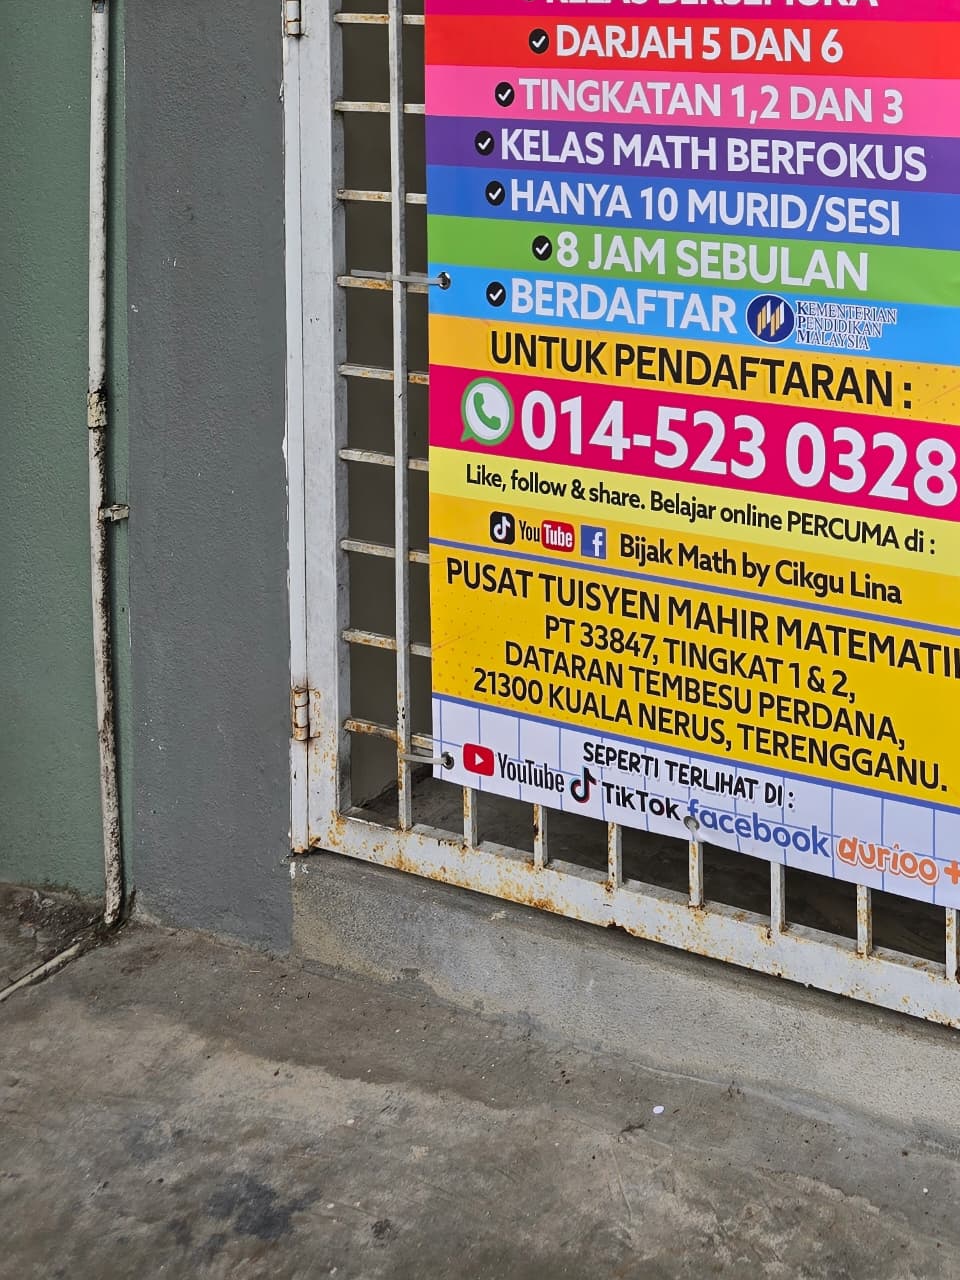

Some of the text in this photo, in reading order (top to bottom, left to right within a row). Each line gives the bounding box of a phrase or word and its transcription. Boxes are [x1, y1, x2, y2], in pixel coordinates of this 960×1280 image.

[556, 25, 811, 61] DARJAH DAN
[519, 78, 872, 123] TINGKATAN 1,2 DAN
[501, 128, 927, 181] KELAS MATH BERFOKUS
[511, 179, 900, 236] HANYA 10 MURID/SESI
[586, 235, 868, 291] JAM SEBULAN
[511, 279, 737, 333] BERDAFTAR
[797, 301, 897, 324] KEMENTERIAN
[797, 316, 882, 336] PENDIDIKAN
[796, 330, 869, 350] MALAYSIA
[491, 332, 893, 407] UNTUK PENDAFTARAN
[520, 389, 957, 507] 014-523 0328
[465, 463, 899, 550] Like, follow share. Belajar online PERCUMA
[620, 535, 902, 605] Bijak Math by Cikgu Lina
[447, 558, 533, 601] PUSAT
[539, 574, 662, 623] TUISYEN
[668, 597, 770, 642] MAHIR
[545, 616, 783, 685] PT 33847, TINGKAT
[505, 641, 905, 750] DATARAN TEMBESU PERDANA,
[474, 668, 948, 791] 21300 KUALA NERUS, TERENGGANU.
[583, 742, 759, 800] SEPERTI TERLIHAT
[498, 753, 830, 858] YouTube TikTok facebook
